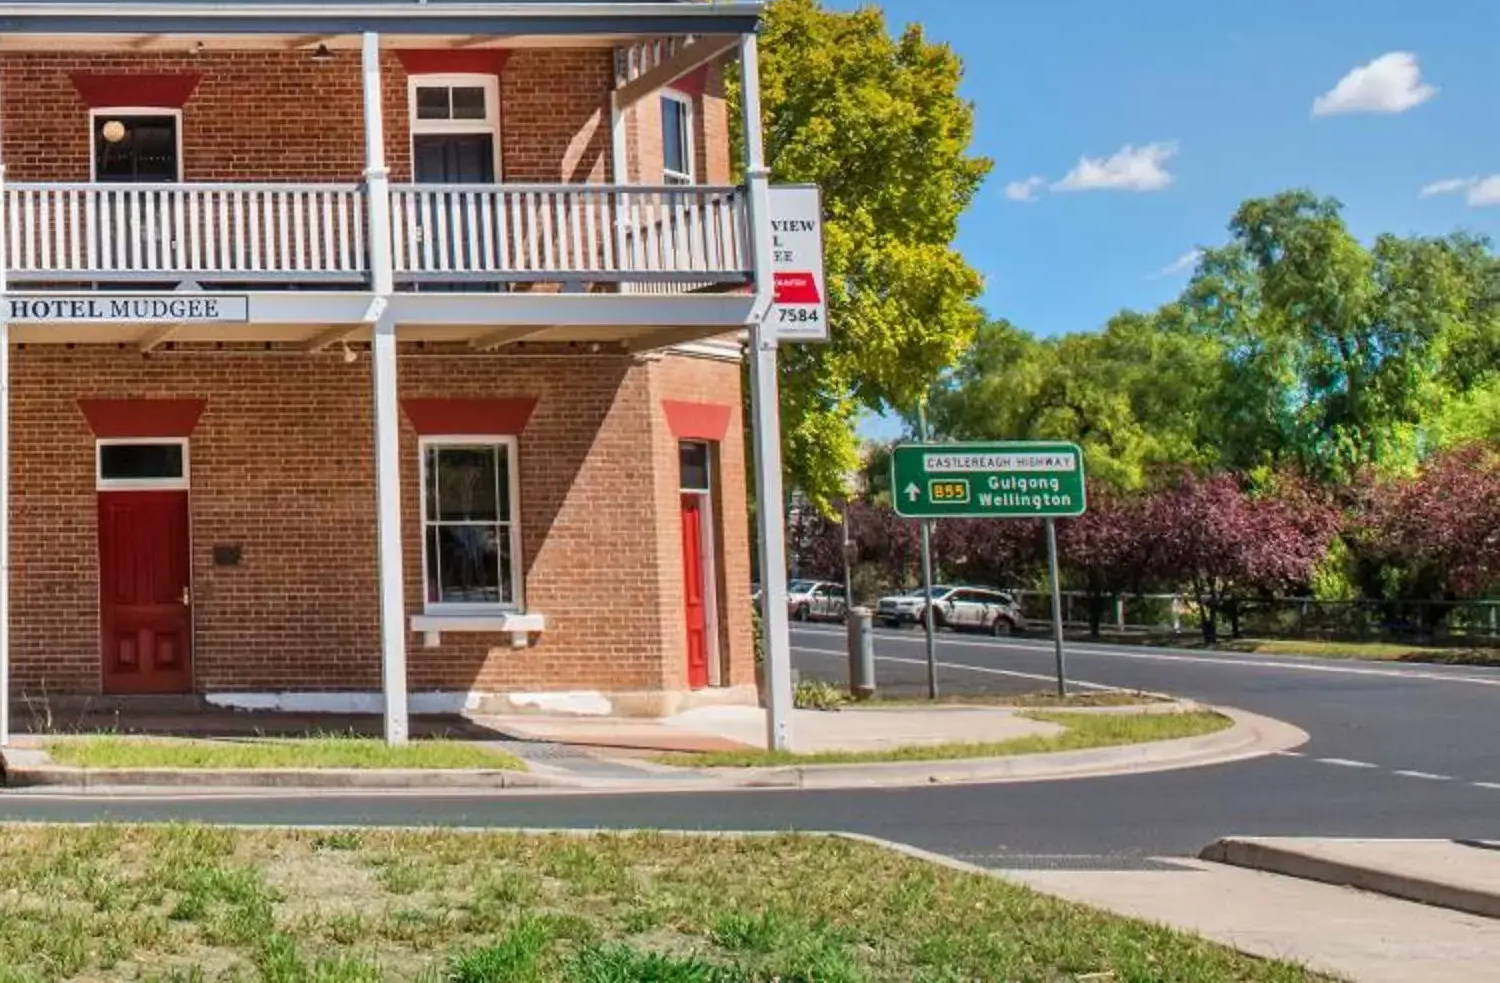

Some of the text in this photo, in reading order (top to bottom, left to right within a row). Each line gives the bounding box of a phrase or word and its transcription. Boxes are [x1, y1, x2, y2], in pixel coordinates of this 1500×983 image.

[11, 300, 102, 318] HOTEL
[110, 299, 219, 318] MUDGEE
[779, 309, 819, 322] 7584
[927, 455, 1070, 468] CASTLEREAGH HIGHWAY
[988, 476, 1059, 492] Gulgong
[980, 493, 1071, 509] Wellington
